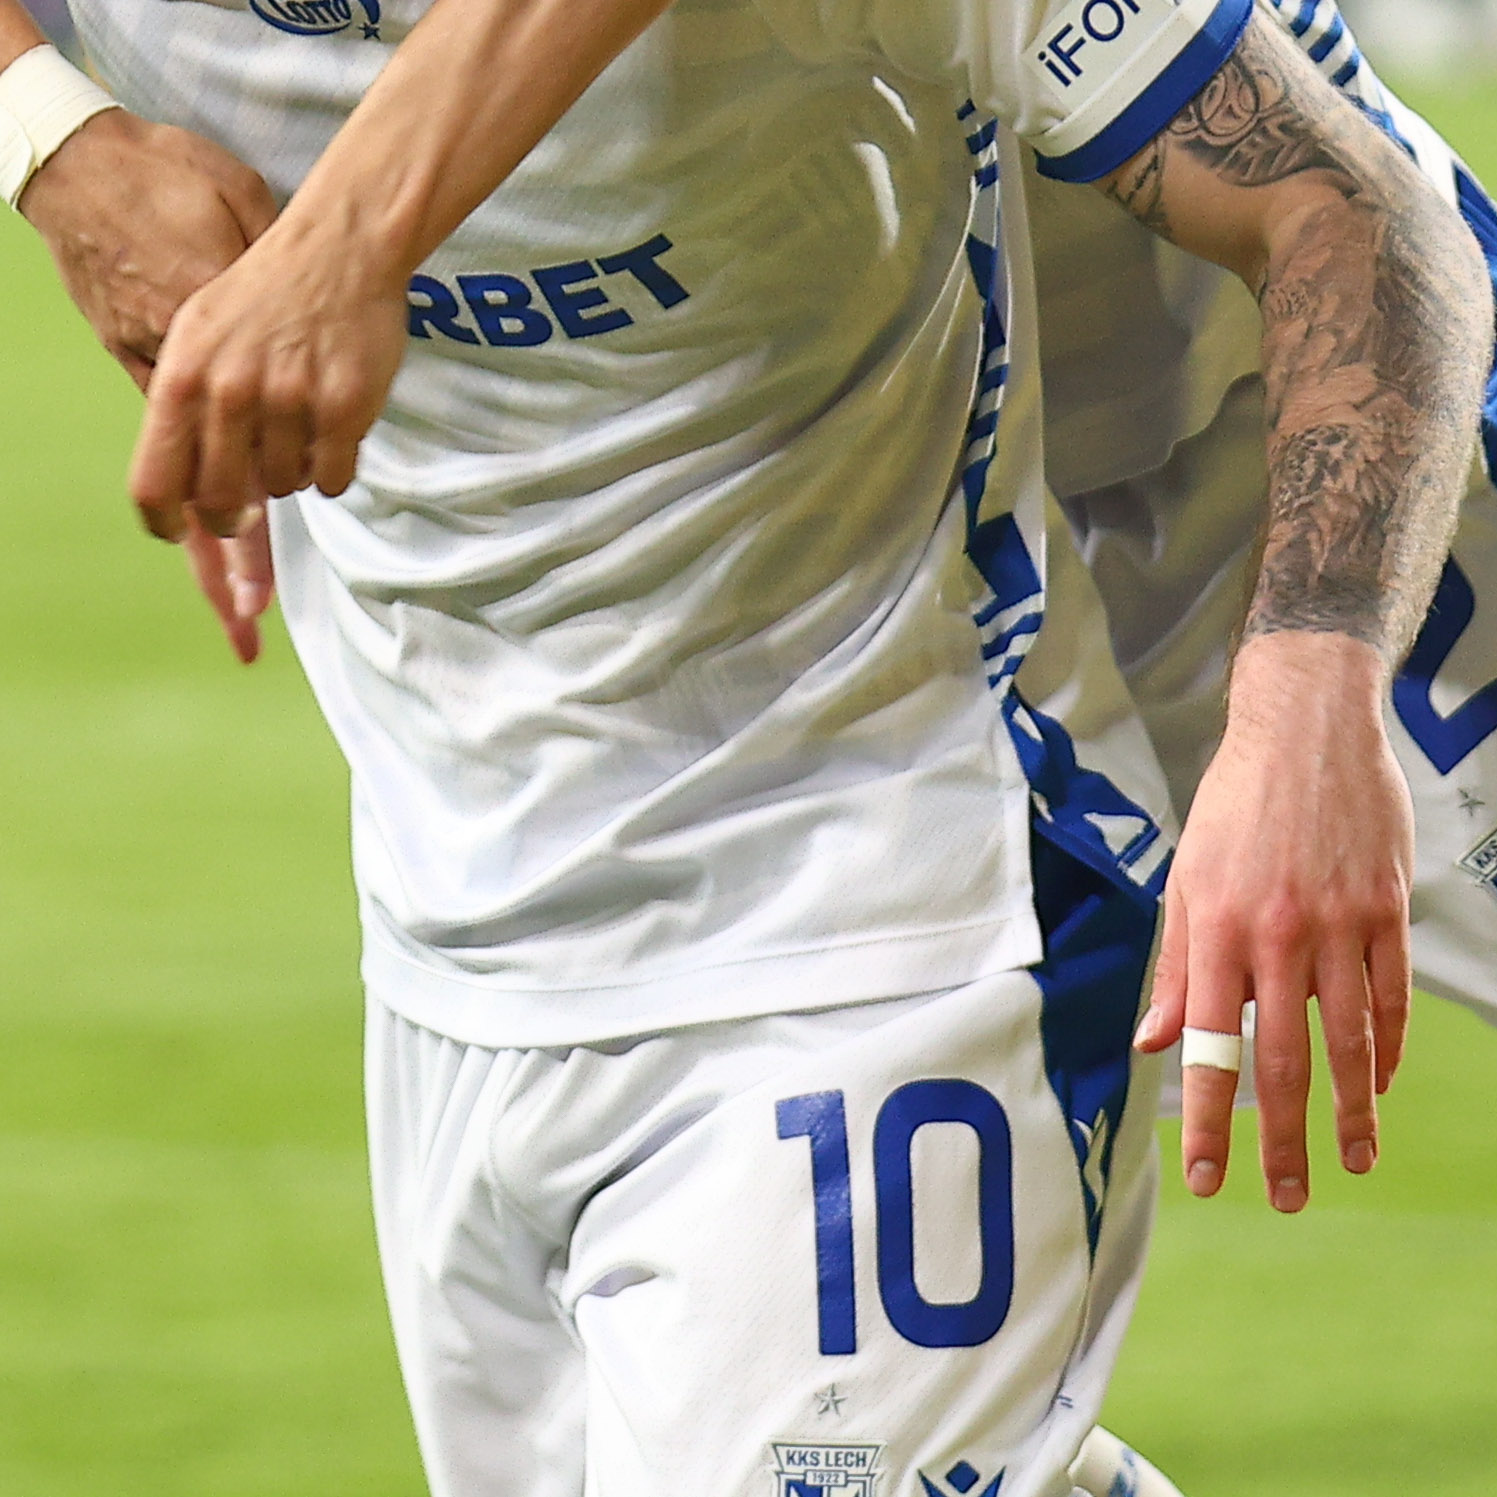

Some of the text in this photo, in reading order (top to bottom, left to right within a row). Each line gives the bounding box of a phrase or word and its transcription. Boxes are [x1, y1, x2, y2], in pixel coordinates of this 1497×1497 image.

[406, 232, 691, 348] RBET
[775, 1077, 1015, 1355] 10
[785, 1449, 868, 1468] KKS LECH
[812, 1472, 840, 1484] 1922
